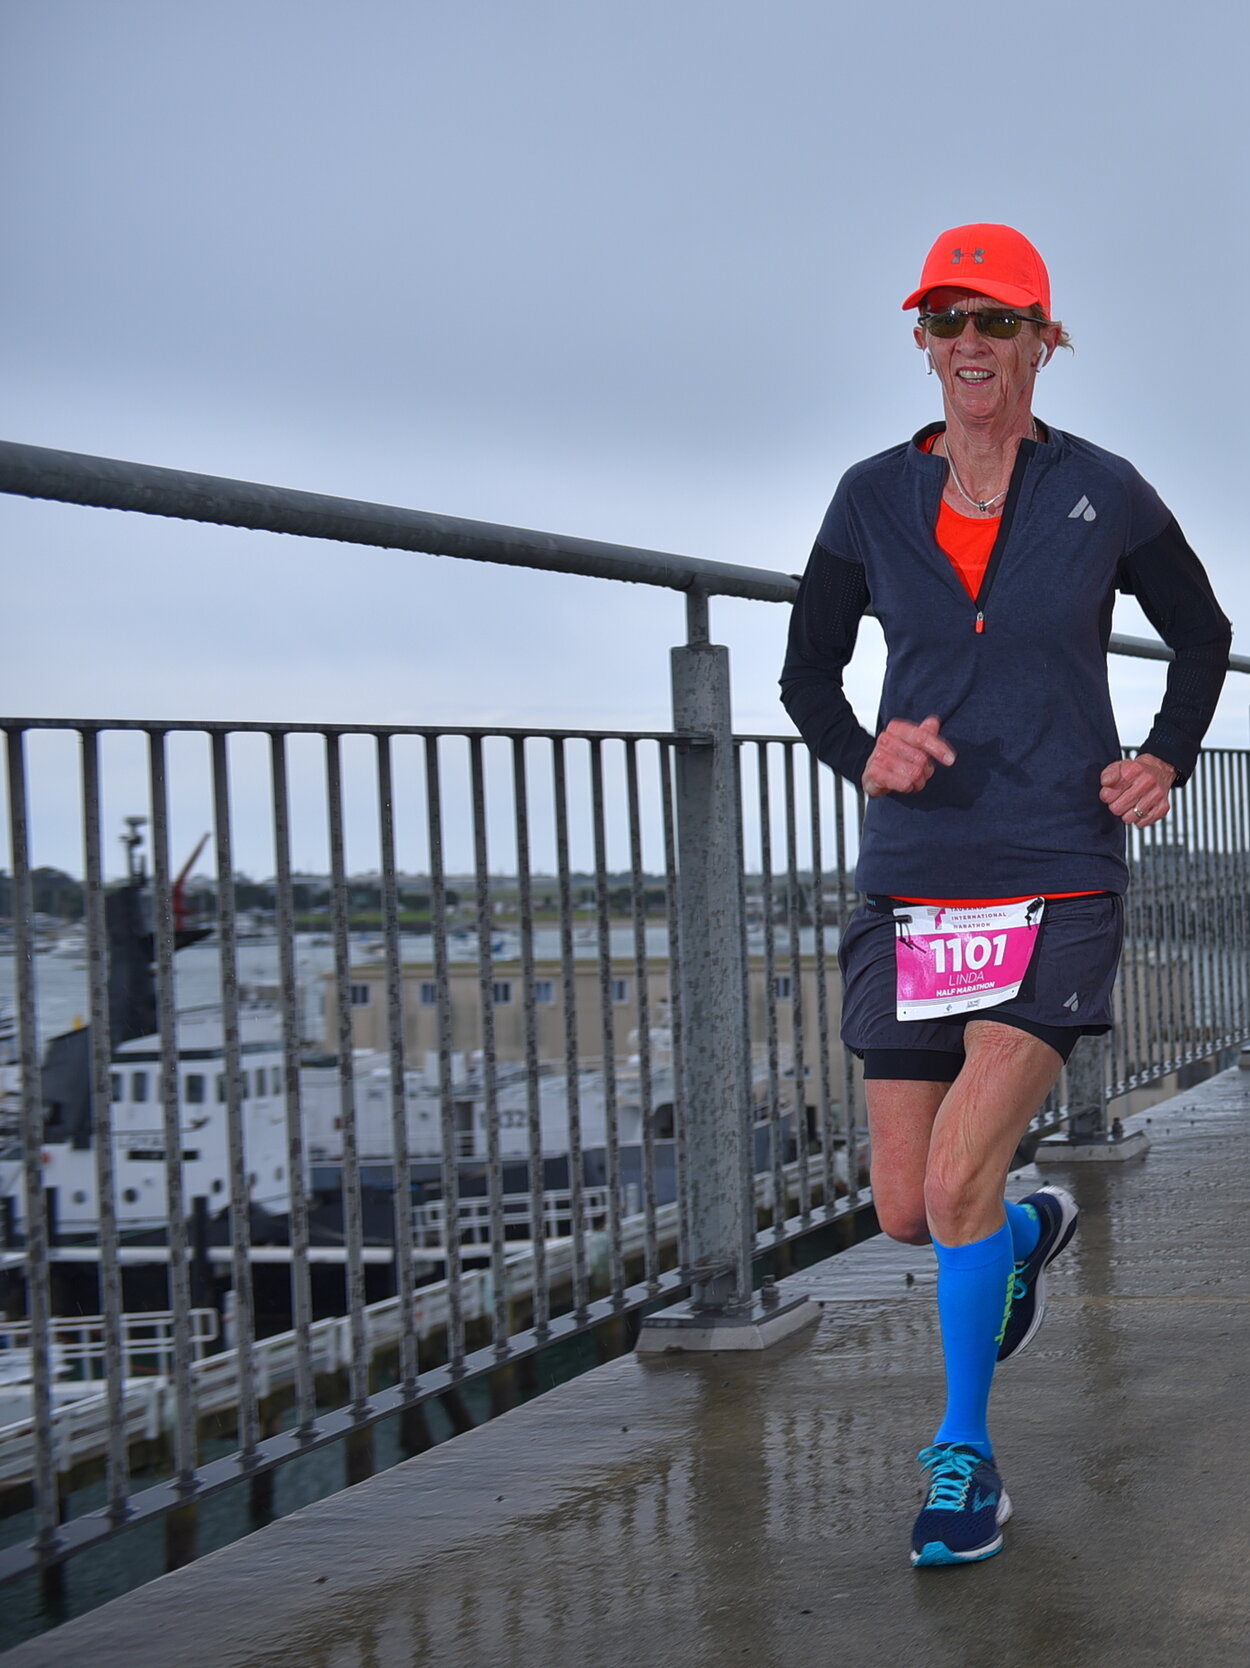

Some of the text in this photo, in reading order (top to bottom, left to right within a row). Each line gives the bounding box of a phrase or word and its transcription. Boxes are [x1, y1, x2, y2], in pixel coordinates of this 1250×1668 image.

[951, 912, 1007, 921] INTERNATIONAL
[929, 934, 1008, 974] 1101
[948, 971, 985, 987] LINDA
[936, 981, 996, 997] HALF MARATHON
